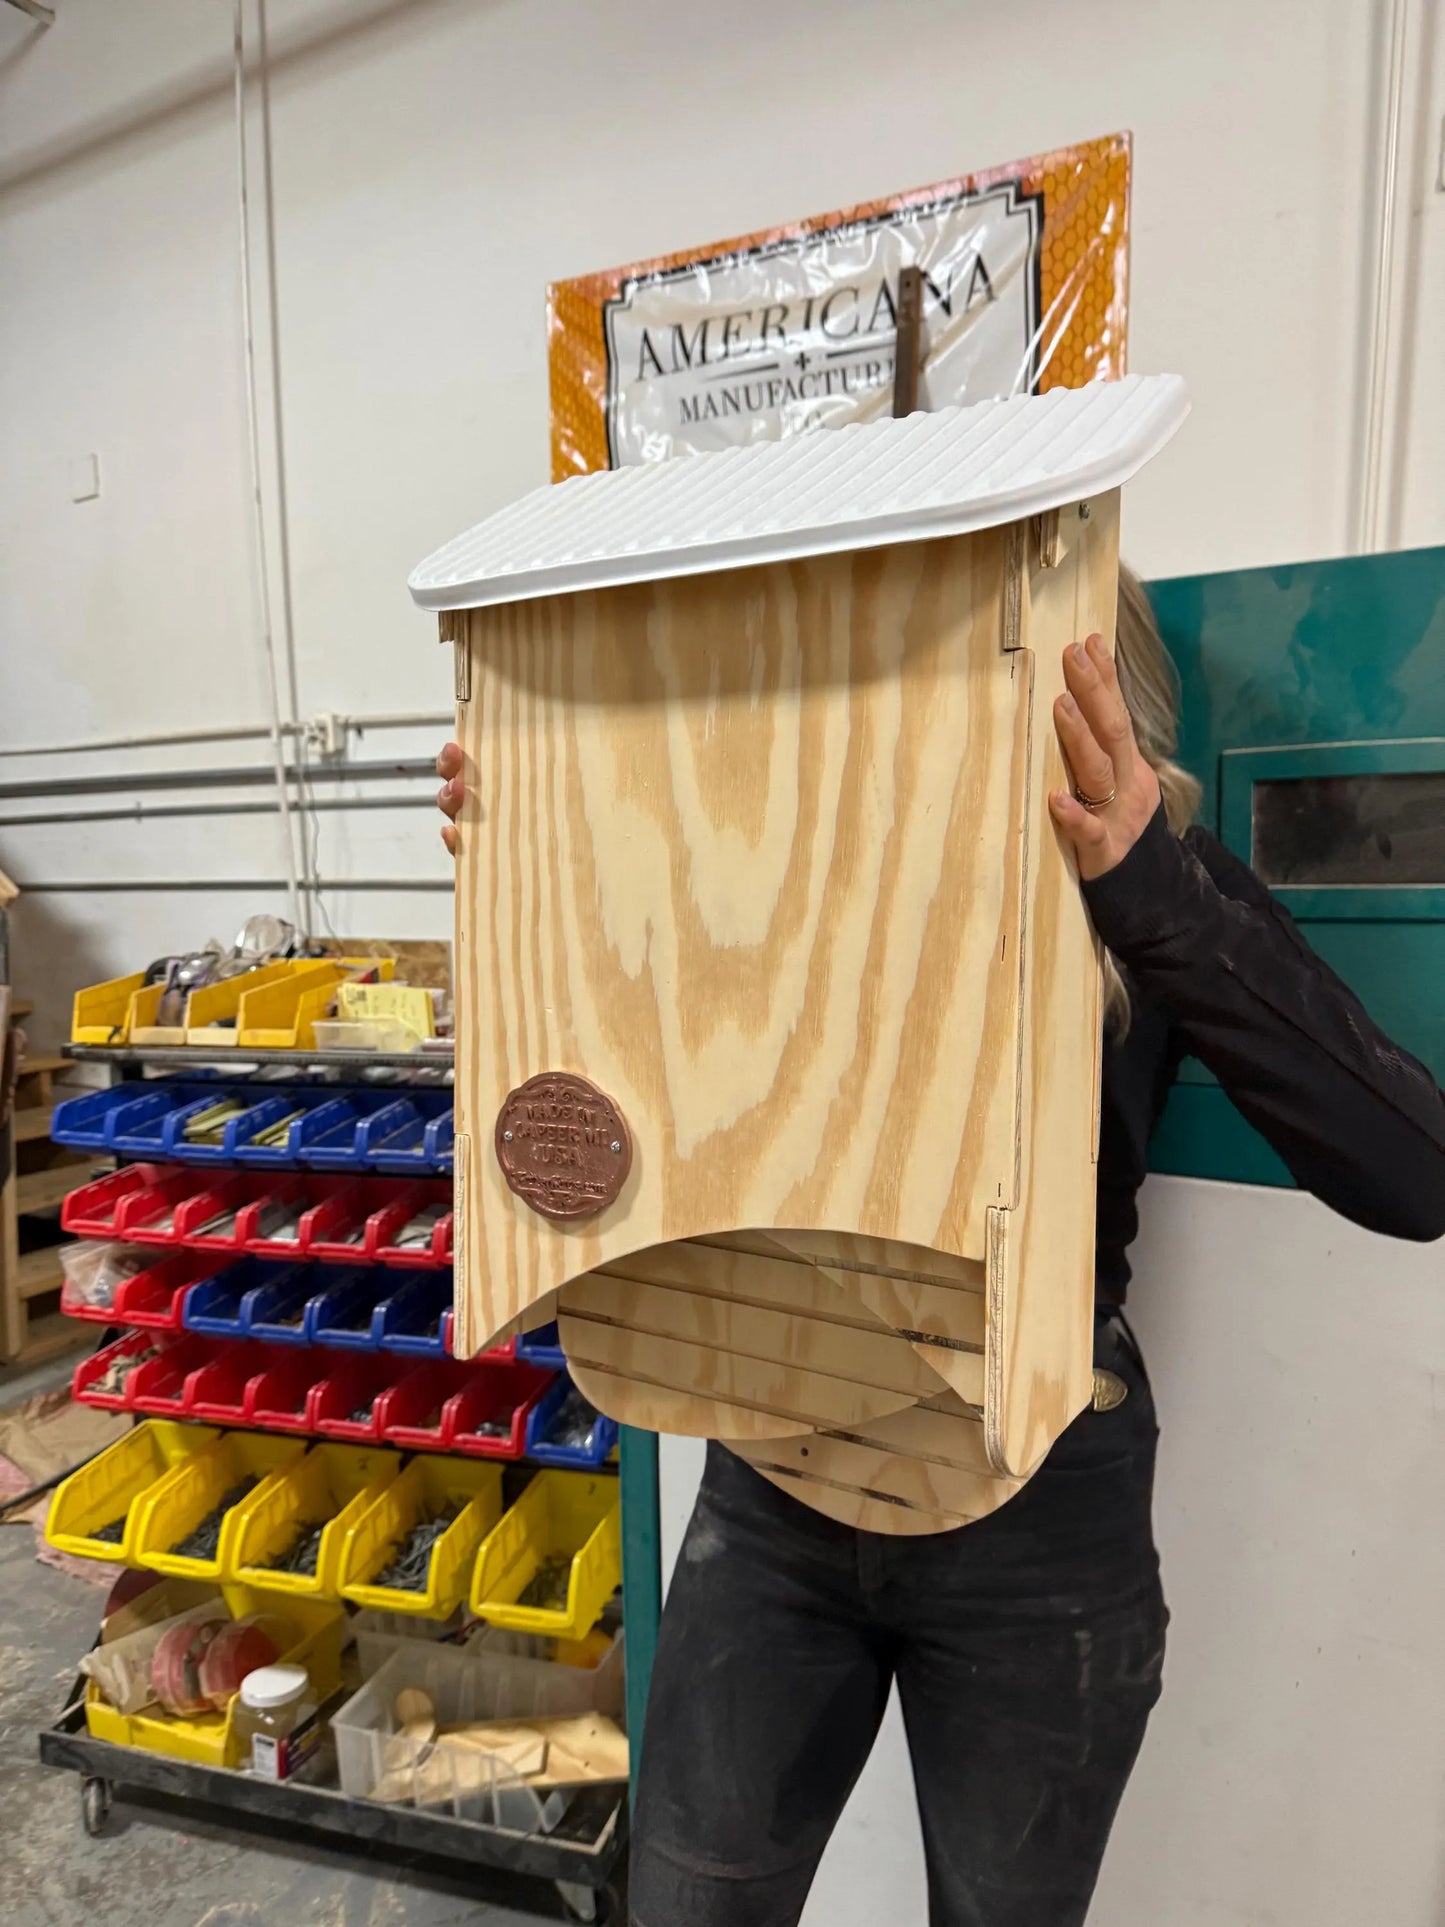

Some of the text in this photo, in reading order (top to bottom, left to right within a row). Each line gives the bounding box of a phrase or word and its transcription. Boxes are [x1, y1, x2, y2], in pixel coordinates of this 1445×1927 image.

[636, 253, 996, 382] AMERICANA
[678, 358, 896, 426] MANUFACTURI
[525, 1104, 574, 1120] MADE
[538, 1143, 583, 1165] USA
